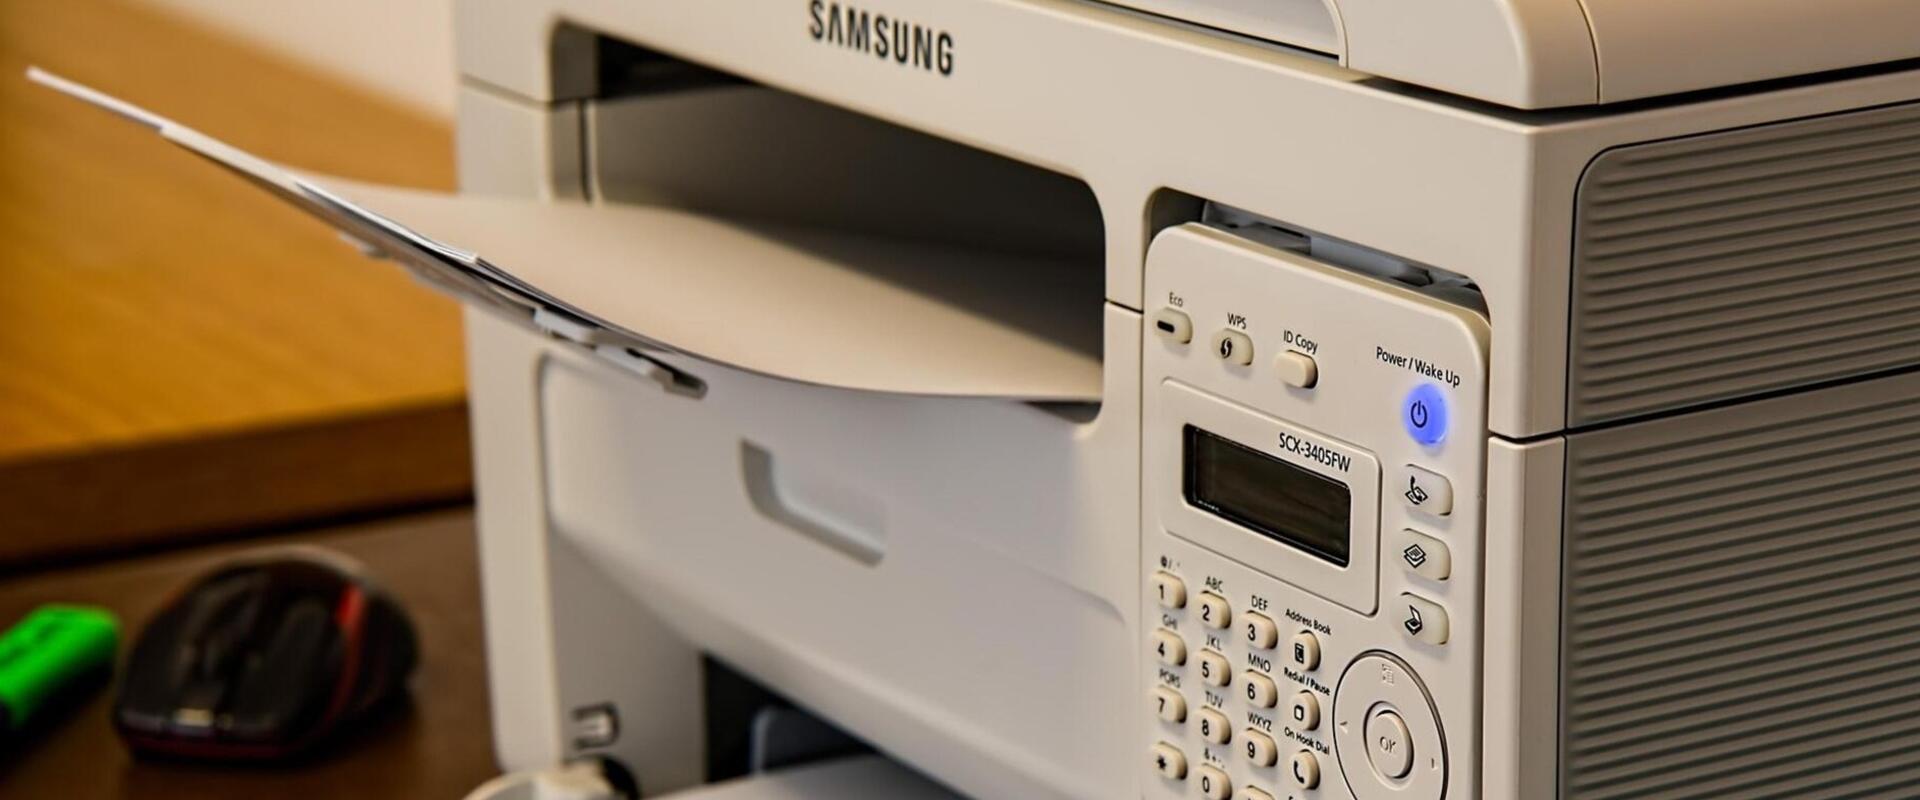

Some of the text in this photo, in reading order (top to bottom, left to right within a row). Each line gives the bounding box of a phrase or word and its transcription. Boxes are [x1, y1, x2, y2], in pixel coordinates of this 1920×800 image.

[809, 0, 953, 76] SAMSUNG
[1169, 292, 1183, 307] Eco
[1227, 312, 1246, 329] WPS
[1283, 330, 1318, 355] ID Copy
[1376, 346, 1460, 388] Power / Wake Up
[1279, 432, 1351, 473] SCX-3405FW
[1158, 584, 1164, 600] 1
[1205, 576, 1223, 593] ABC
[1251, 595, 1268, 611] DEF
[1202, 604, 1210, 622] 2
[1285, 608, 1331, 636] Address Book
[1247, 623, 1256, 641] 3
[1157, 641, 1165, 657] 4
[1206, 634, 1221, 651] JKL
[1202, 660, 1210, 678] 5
[1248, 653, 1271, 673] MNO
[1284, 667, 1305, 684] Redial
[1310, 679, 1331, 696] Pause
[1205, 690, 1223, 708] TUV
[1247, 682, 1256, 700] 6
[1158, 696, 1166, 714] 7
[1202, 718, 1209, 737] 8
[1247, 711, 1272, 733] WXYZ
[1284, 726, 1330, 755] On Hook Dial
[1379, 736, 1396, 753] OK
[1247, 741, 1256, 759] 9
[1202, 776, 1210, 793] 0
